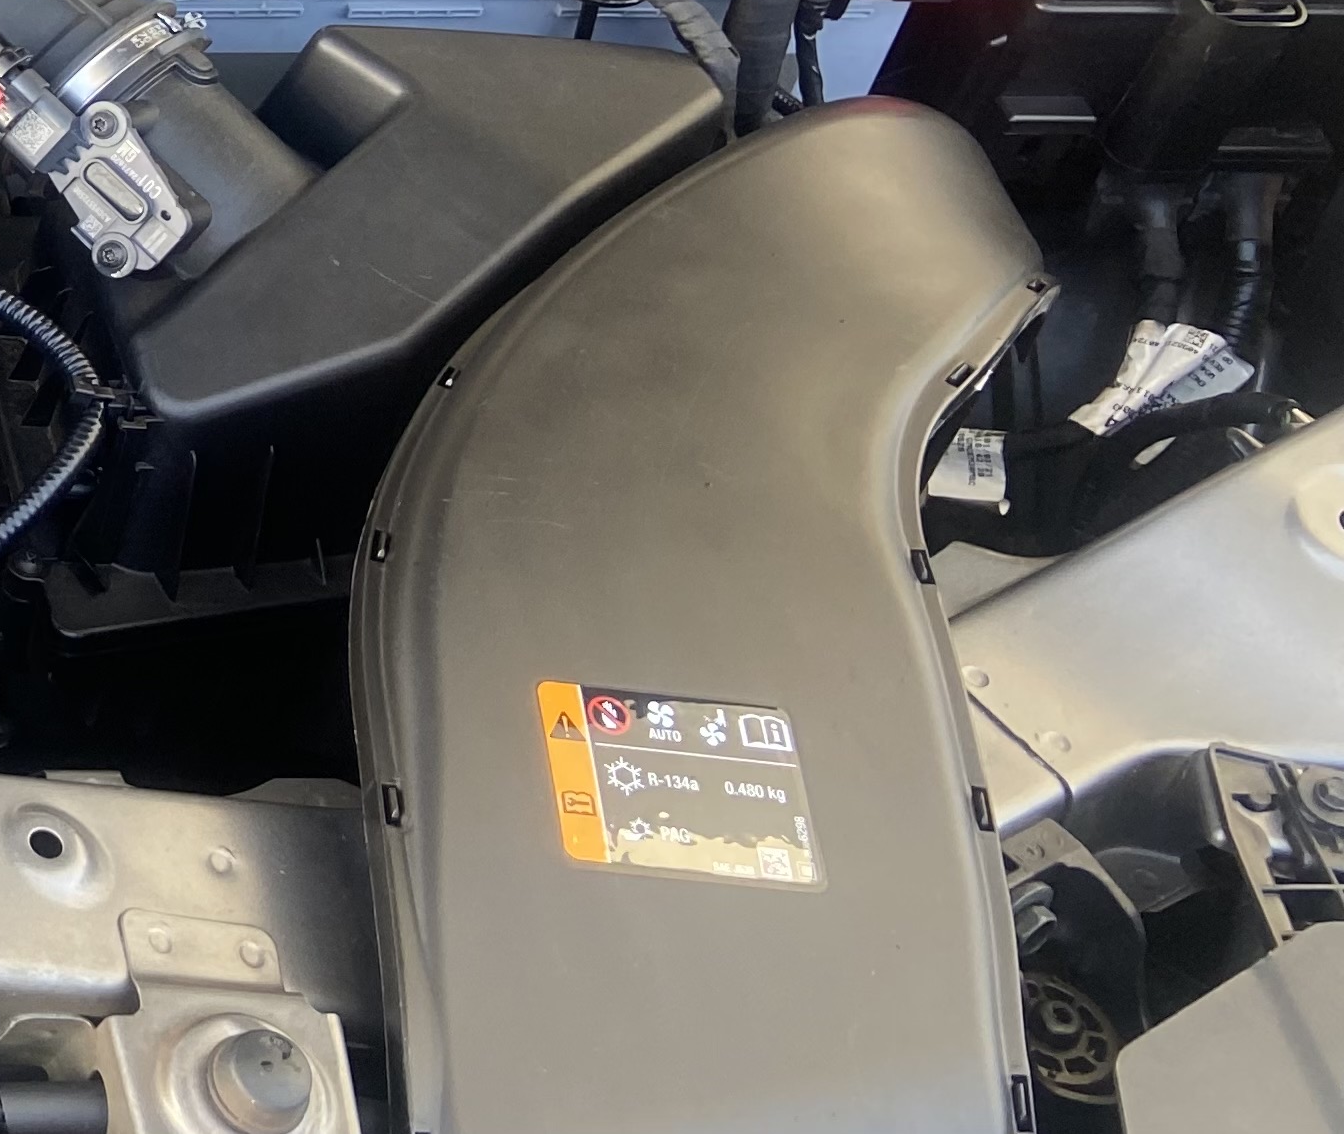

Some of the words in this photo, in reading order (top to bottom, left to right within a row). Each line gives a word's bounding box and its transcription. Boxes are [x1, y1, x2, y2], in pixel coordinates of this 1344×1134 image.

[648, 728, 682, 743] AUTO
[647, 772, 700, 791] R-134a
[724, 780, 764, 799] 0.480
[768, 785, 787, 804] kg
[660, 826, 691, 844] PAG
